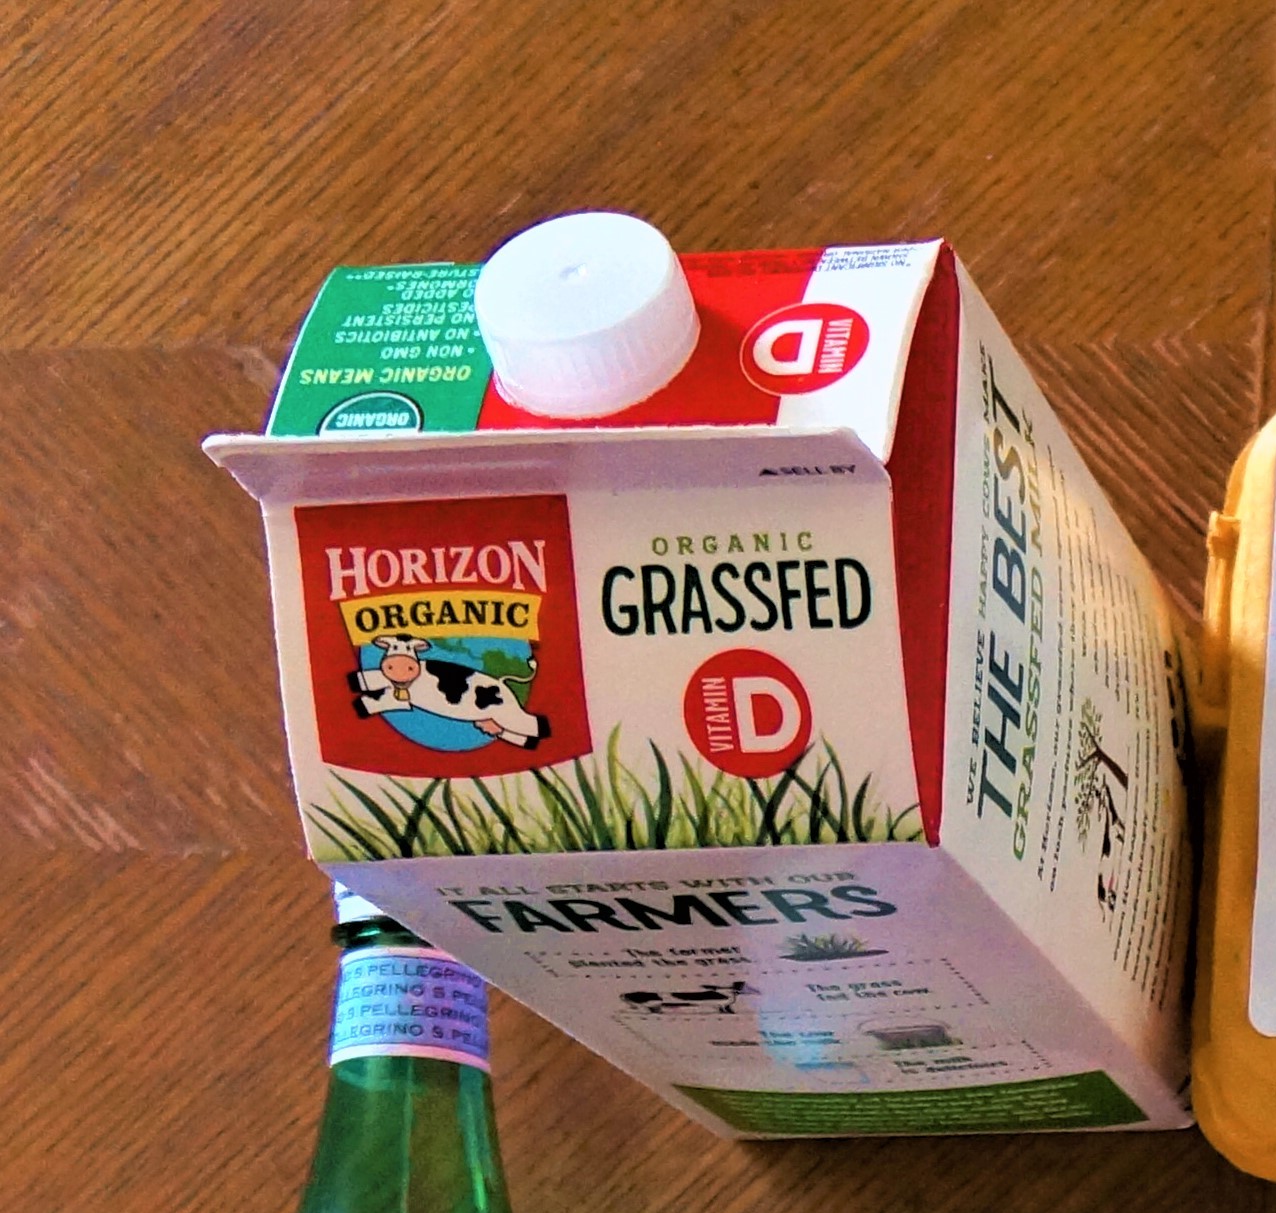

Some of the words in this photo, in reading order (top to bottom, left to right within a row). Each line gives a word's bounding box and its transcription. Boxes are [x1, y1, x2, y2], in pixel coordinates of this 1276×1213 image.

[335, 329, 441, 343] ANTIBIOTICS
[818, 318, 853, 373] VITAMIN
[300, 366, 374, 384] MEANS
[379, 365, 472, 383] ORGANIC
[336, 412, 410, 427] ORGANIC
[992, 353, 1027, 624] BEST
[651, 531, 813, 556] ORGANIC
[325, 540, 547, 600] HORIZON
[355, 600, 531, 635] ORGANIC
[601, 558, 872, 636] GRASSFED
[701, 677, 734, 753] VITAMIN
[732, 676, 802, 753] D
[977, 629, 1025, 820] THE
[448, 885, 899, 934] FARMERS
